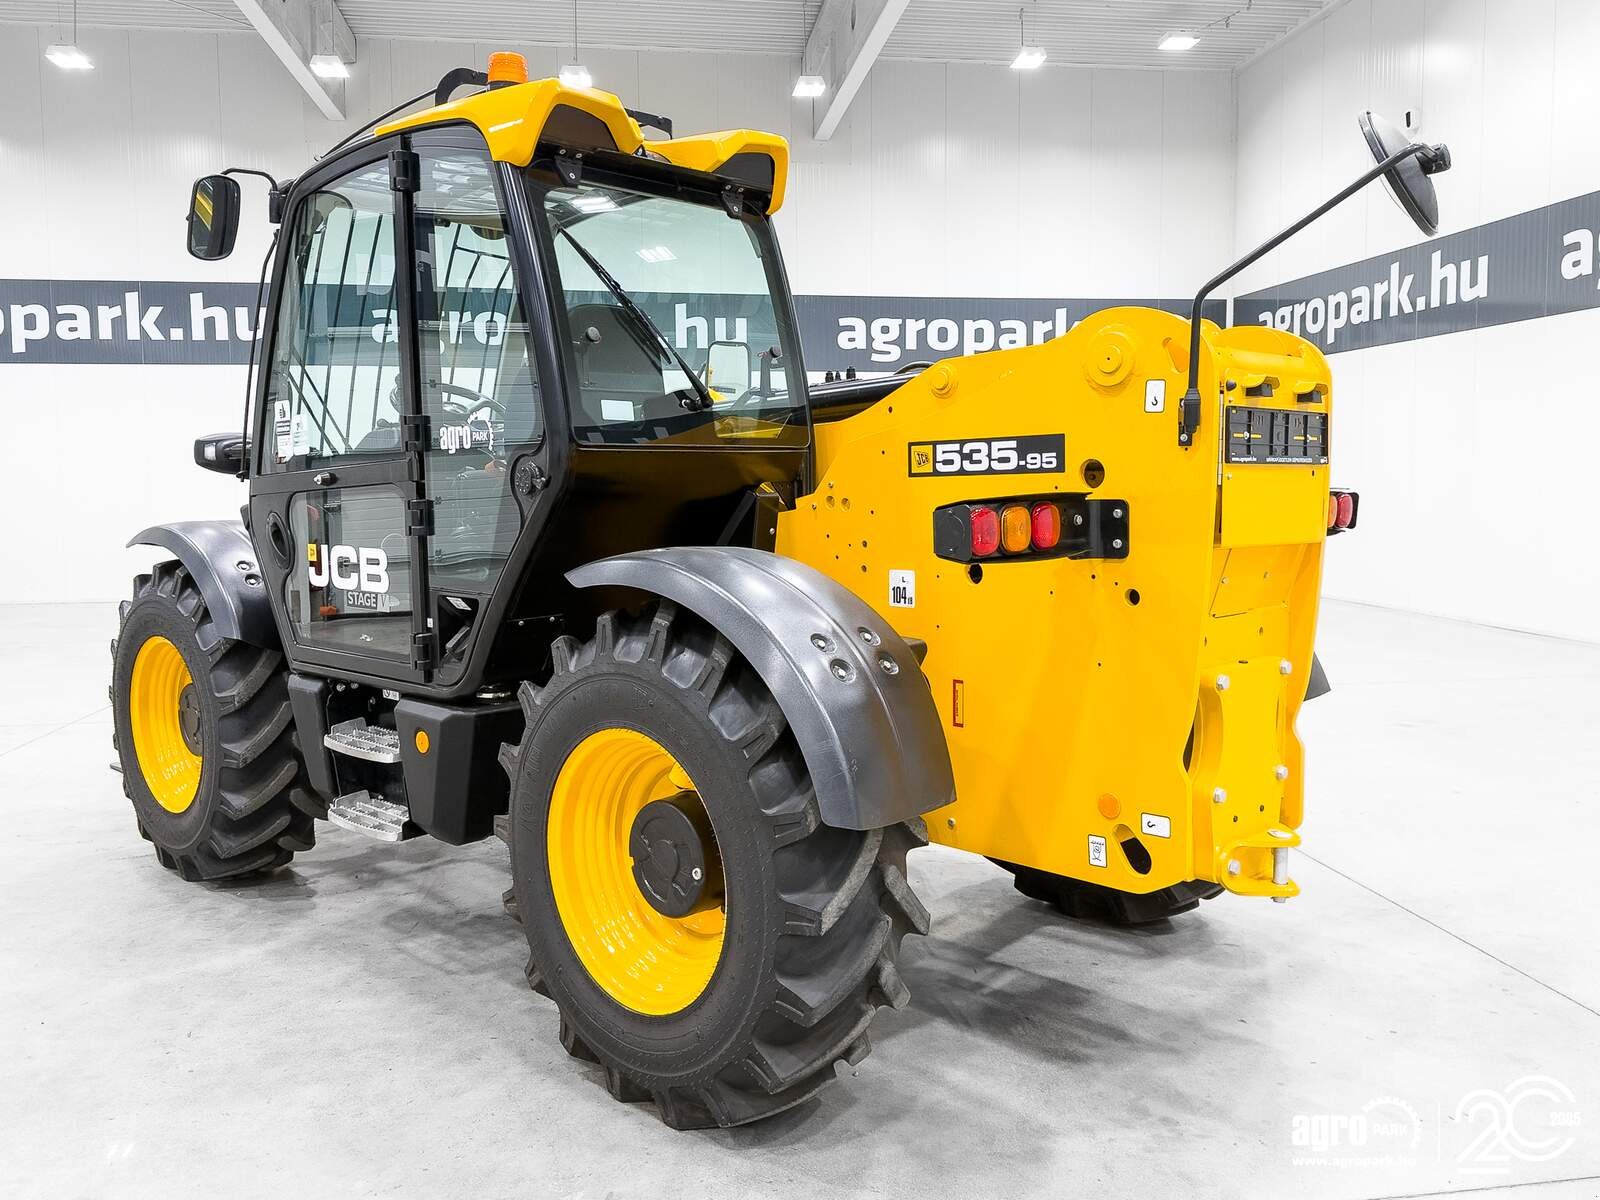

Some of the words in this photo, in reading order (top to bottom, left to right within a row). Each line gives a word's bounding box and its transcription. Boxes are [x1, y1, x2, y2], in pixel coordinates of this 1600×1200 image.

[1560, 228, 1600, 290] a
[439, 425, 472, 454] agro
[472, 431, 489, 441] PARK
[914, 450, 930, 468] JCB
[935, 440, 1057, 473] 535-95
[308, 544, 390, 594] JCB
[347, 591, 377, 607] STAGE
[892, 586, 907, 605] 104
